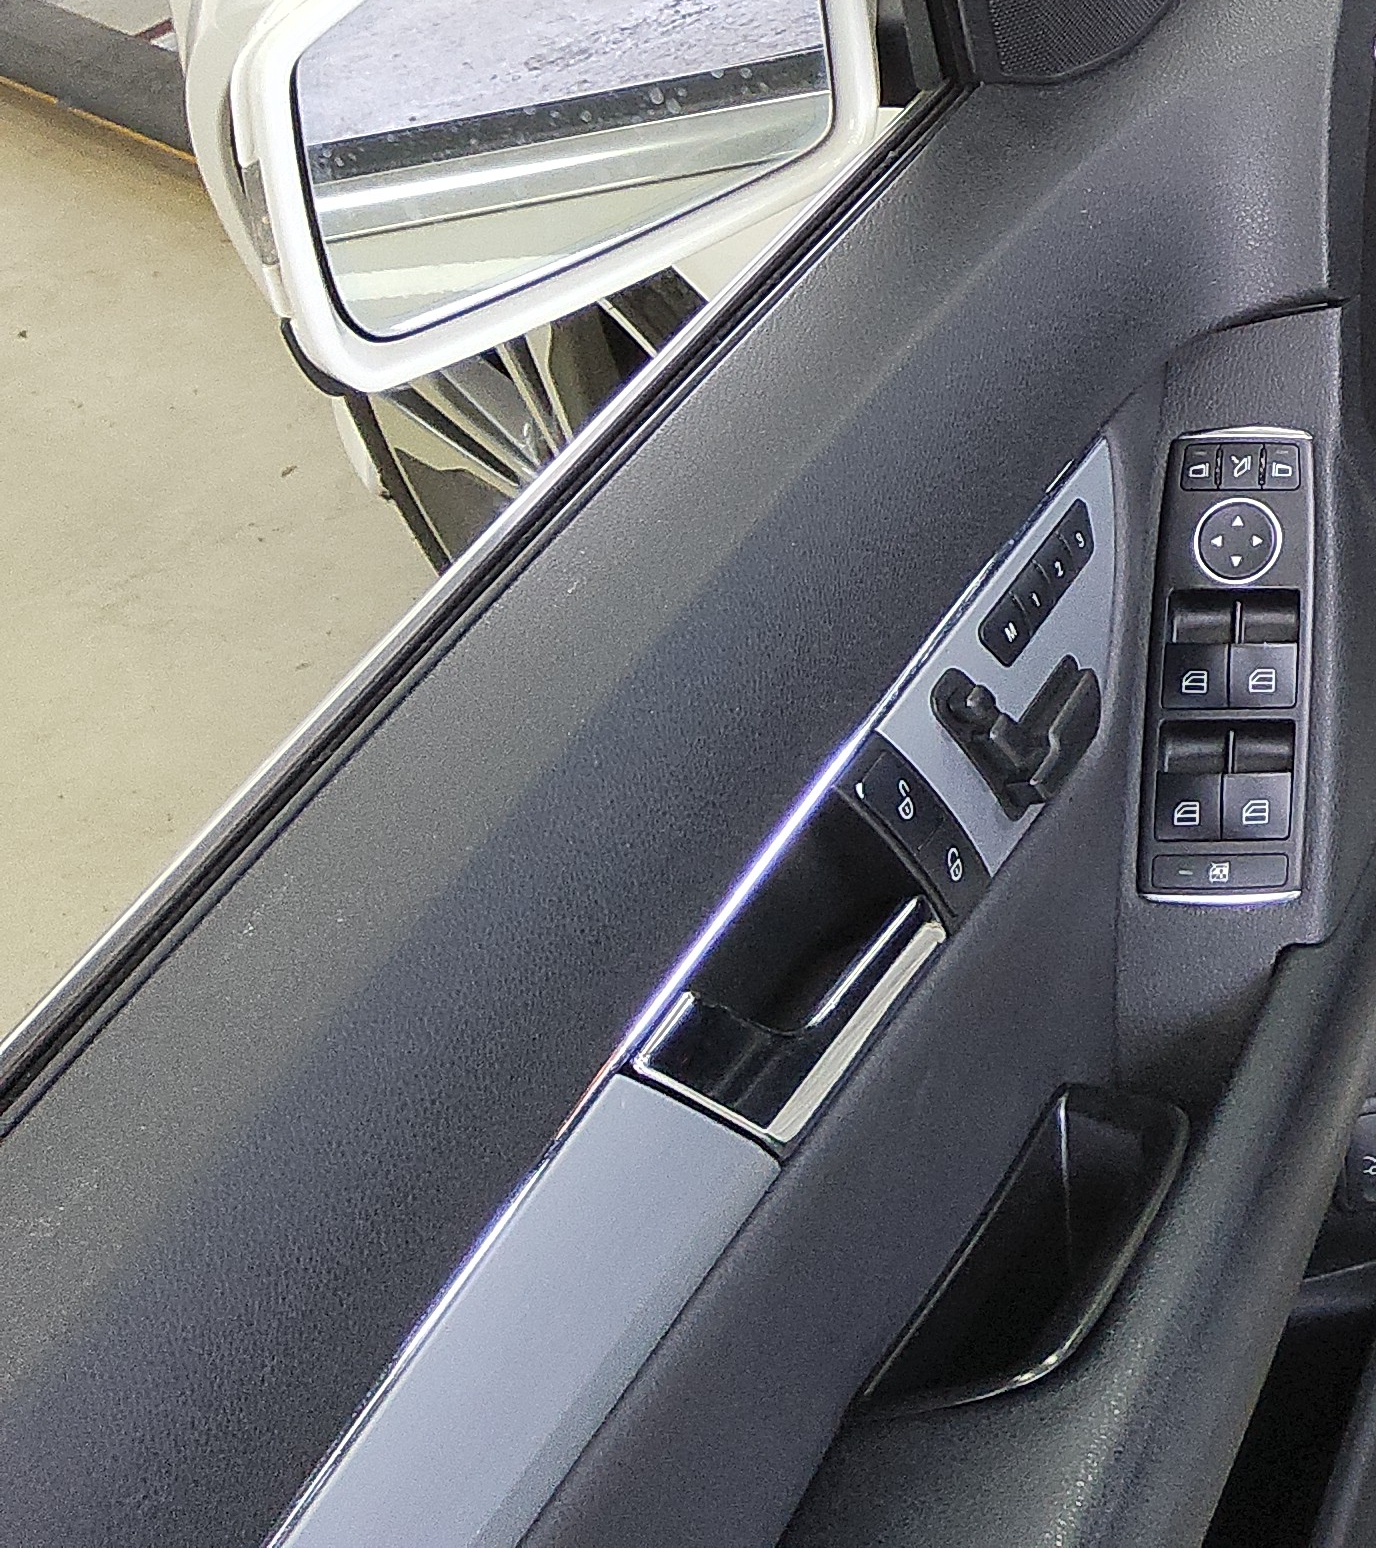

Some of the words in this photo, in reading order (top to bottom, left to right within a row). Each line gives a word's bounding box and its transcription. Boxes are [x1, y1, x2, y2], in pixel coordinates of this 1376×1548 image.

[1004, 621, 1018, 643] M
[1031, 592, 1041, 607] 1
[1054, 560, 1064, 577] 2
